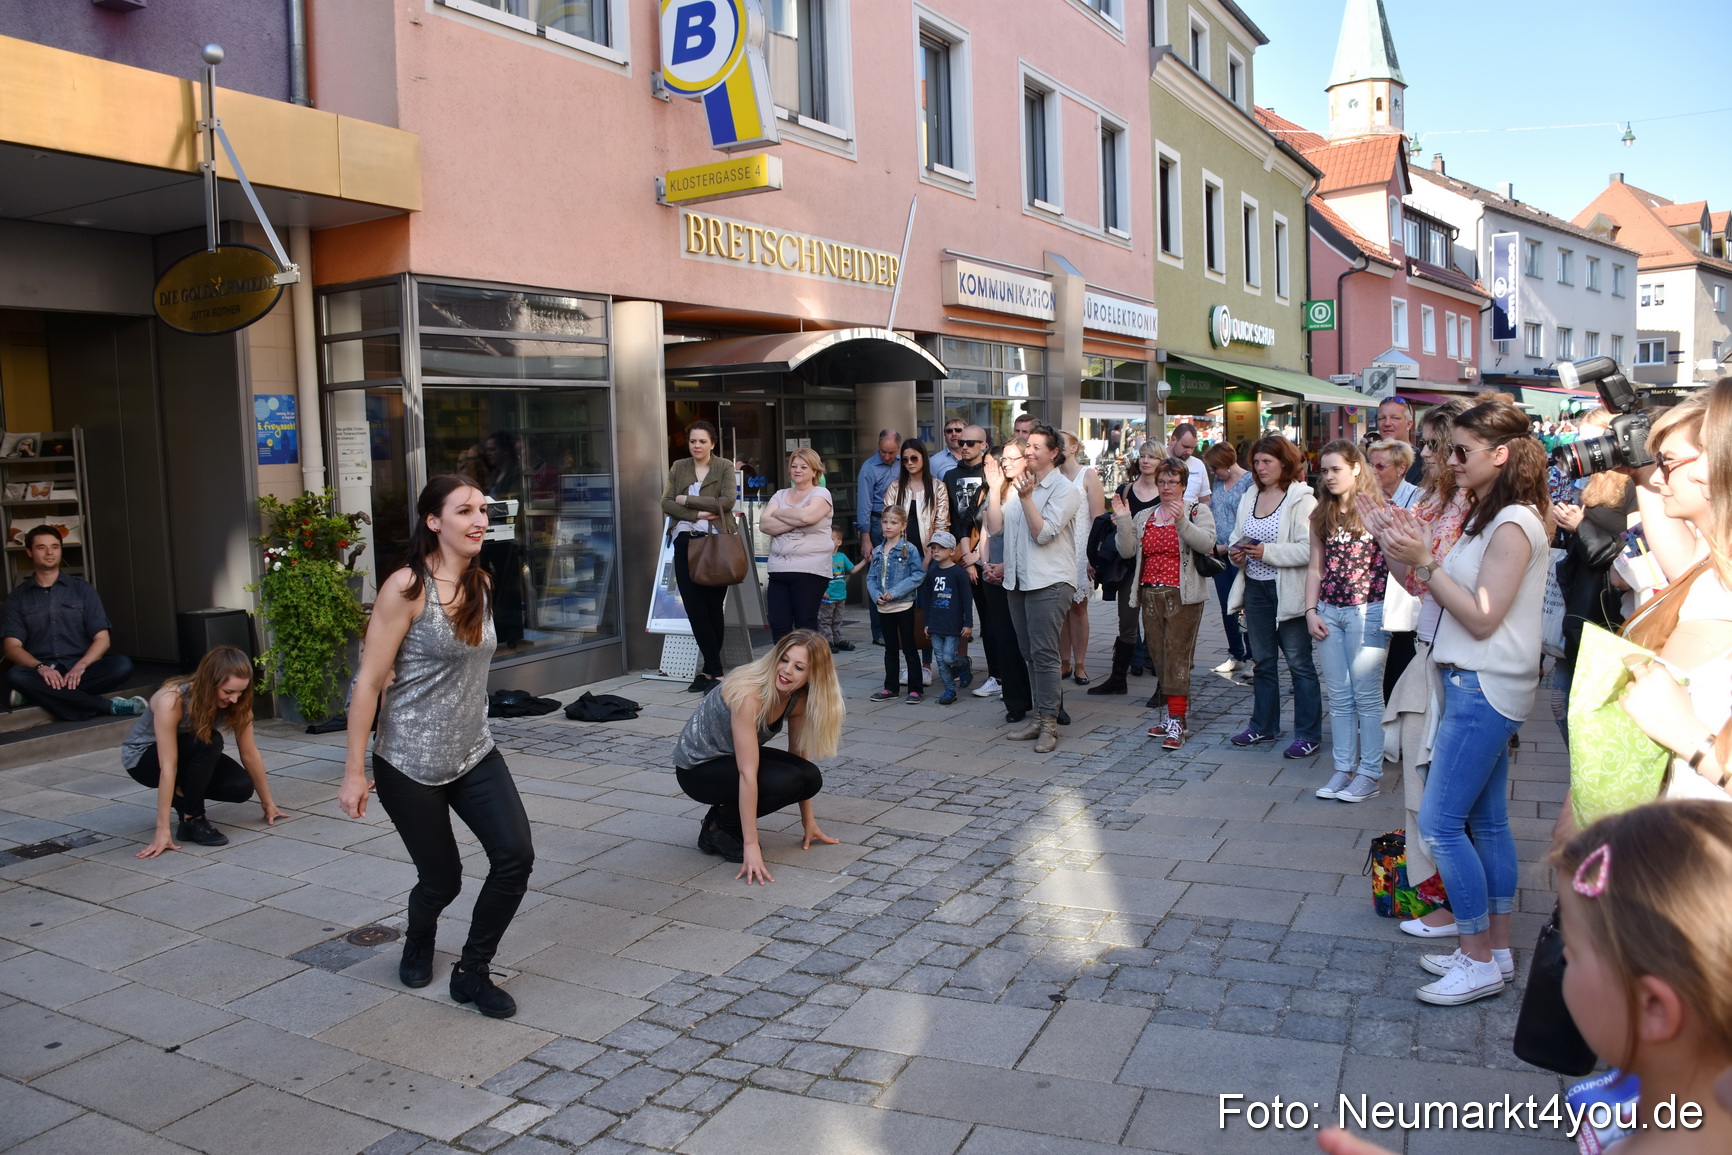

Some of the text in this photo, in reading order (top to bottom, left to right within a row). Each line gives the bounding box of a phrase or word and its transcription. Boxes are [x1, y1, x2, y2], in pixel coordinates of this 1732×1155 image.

[670, 164, 761, 192] KLOSTERGASSE 4
[684, 212, 901, 288] BRETSCHNEIDER
[159, 289, 179, 306] DIE
[958, 271, 1057, 312] KOMMUNIKATION
[189, 305, 241, 321] JUTTA ROTHER
[1231, 318, 1275, 347] QUICK SCHUH
[933, 576, 946, 592] 25
